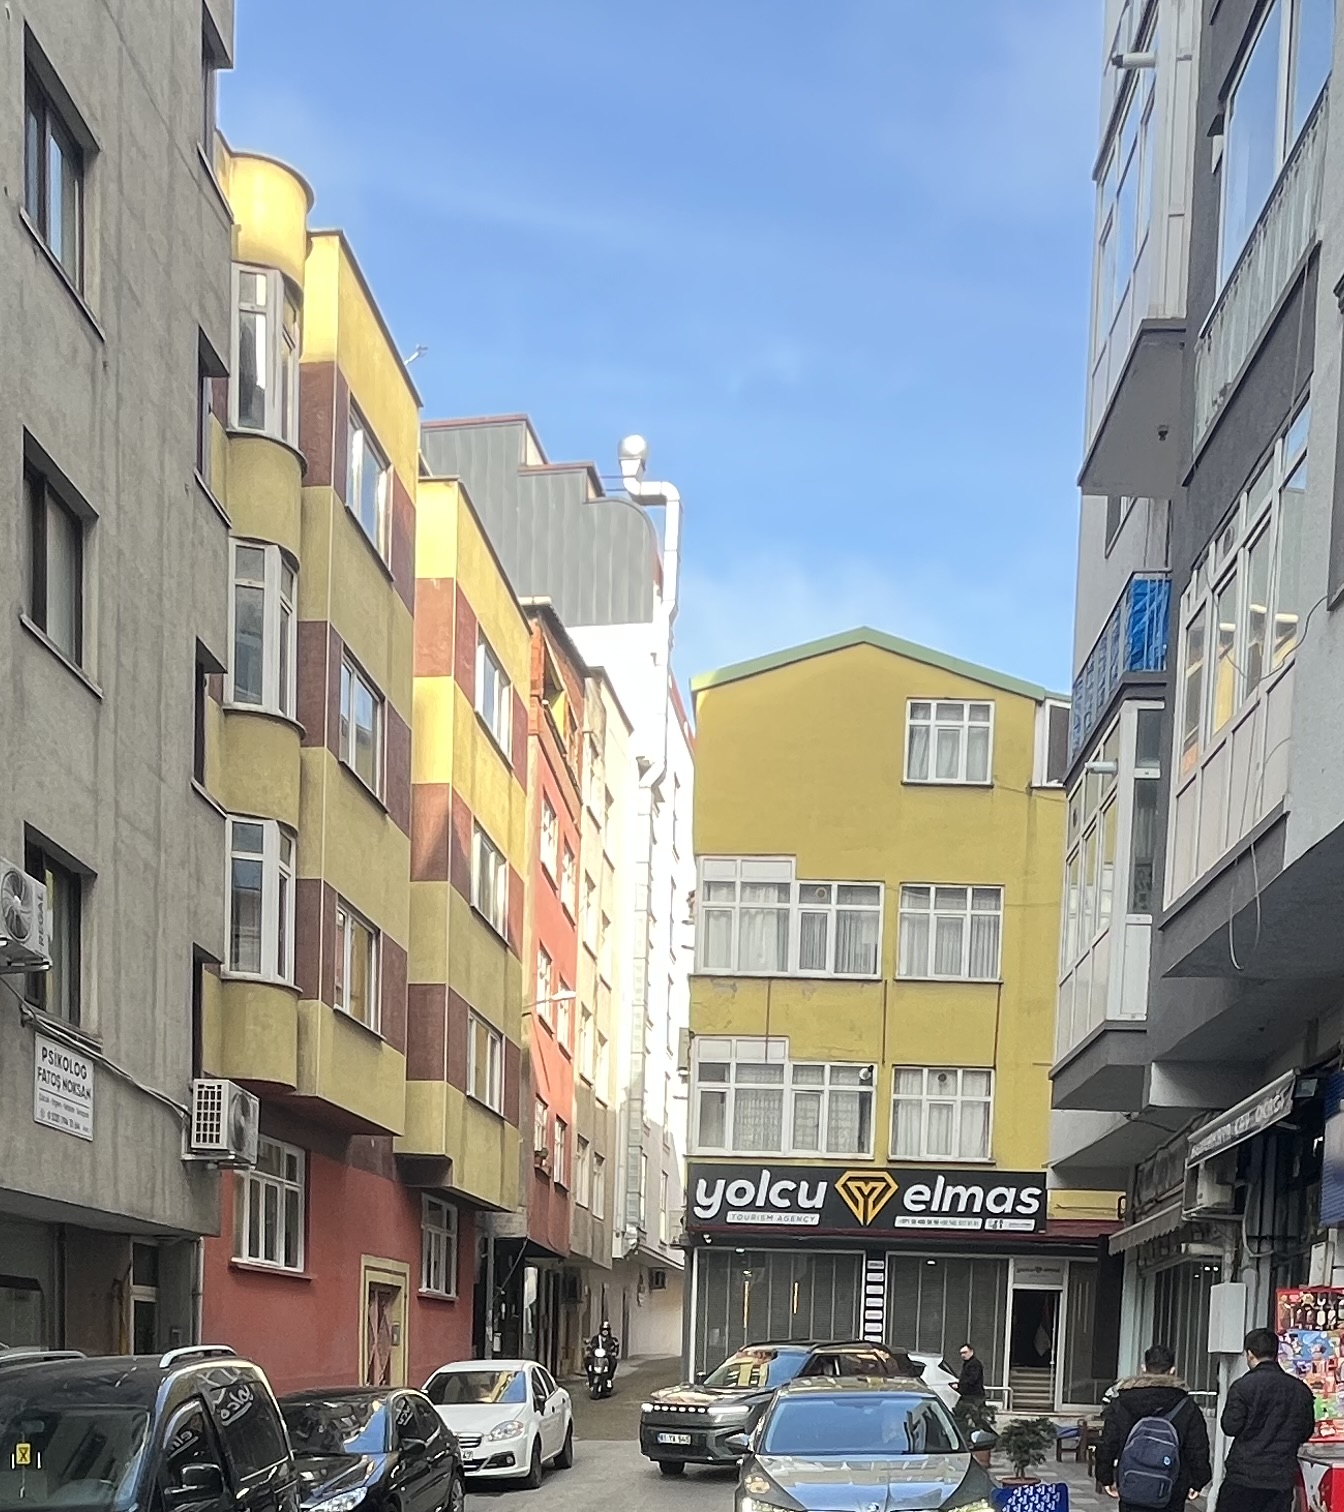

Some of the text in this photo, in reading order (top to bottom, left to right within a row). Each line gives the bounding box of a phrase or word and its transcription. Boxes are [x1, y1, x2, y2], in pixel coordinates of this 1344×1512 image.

[693, 1168, 828, 1219] yolcu
[903, 1174, 1043, 1215] elmas
[731, 1213, 816, 1223] TOURISM AGENCY
